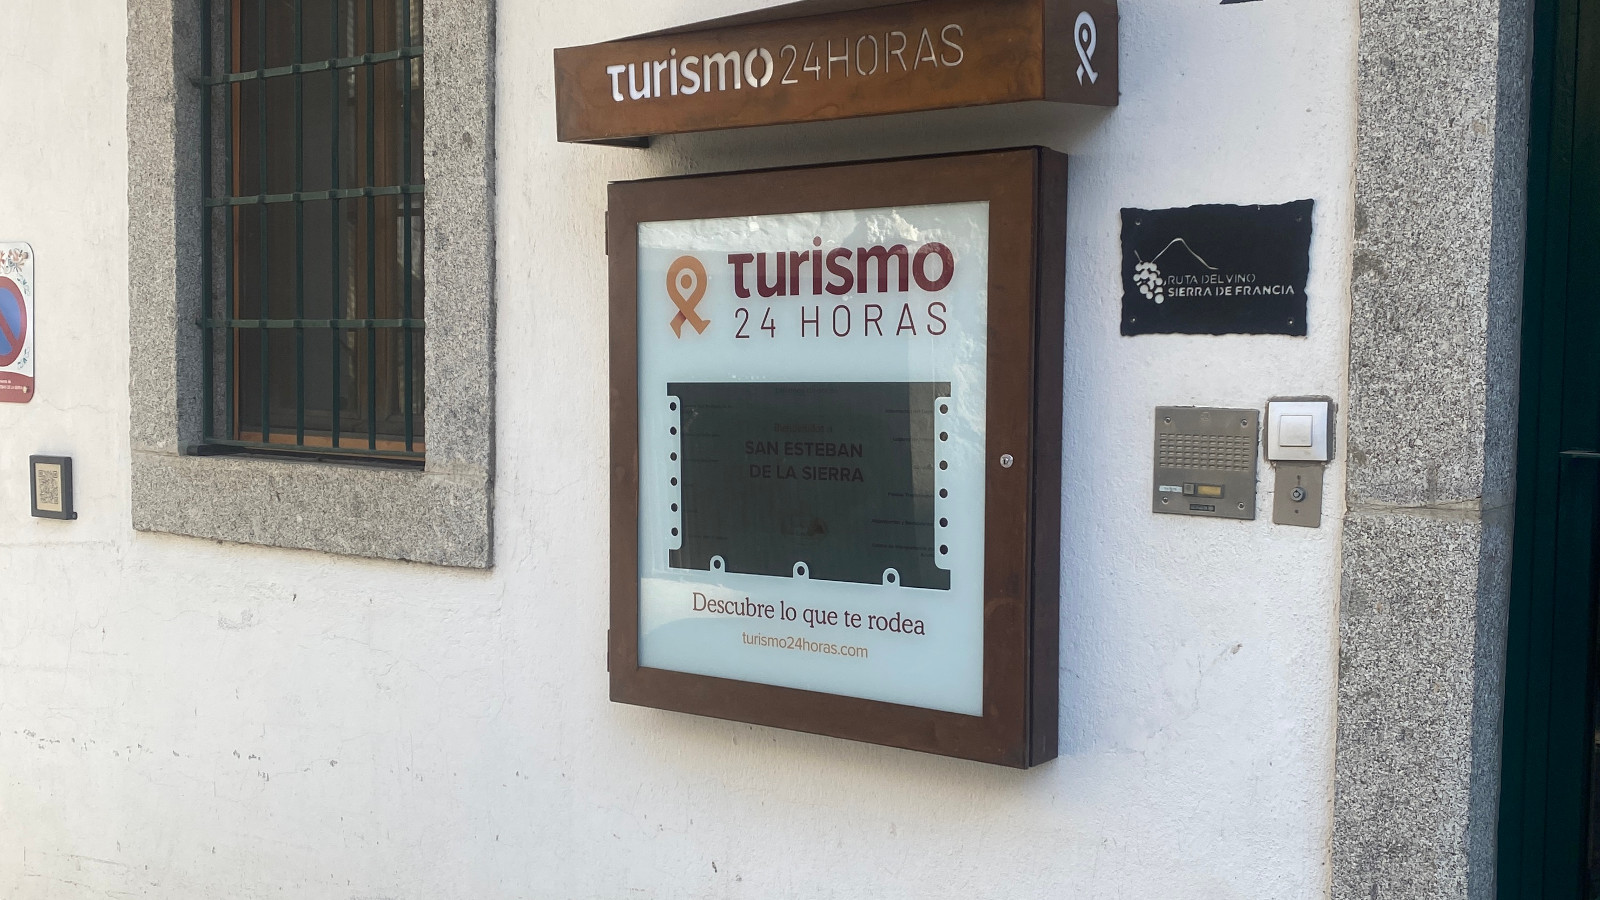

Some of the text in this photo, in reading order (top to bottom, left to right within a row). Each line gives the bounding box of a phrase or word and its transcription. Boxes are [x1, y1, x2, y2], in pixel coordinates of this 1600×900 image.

[727, 235, 955, 299] turismo
[1168, 274, 1199, 285] RUTA
[1168, 284, 1295, 297] SIERRA DE FRANCIA
[734, 301, 947, 339] 24 HORAS
[745, 440, 863, 458] SAN ESTEBAN
[749, 464, 864, 482] DE LA SIERRA
[692, 592, 925, 636] Descubre lo que te rodea
[741, 631, 868, 659] turismo24horas.com
